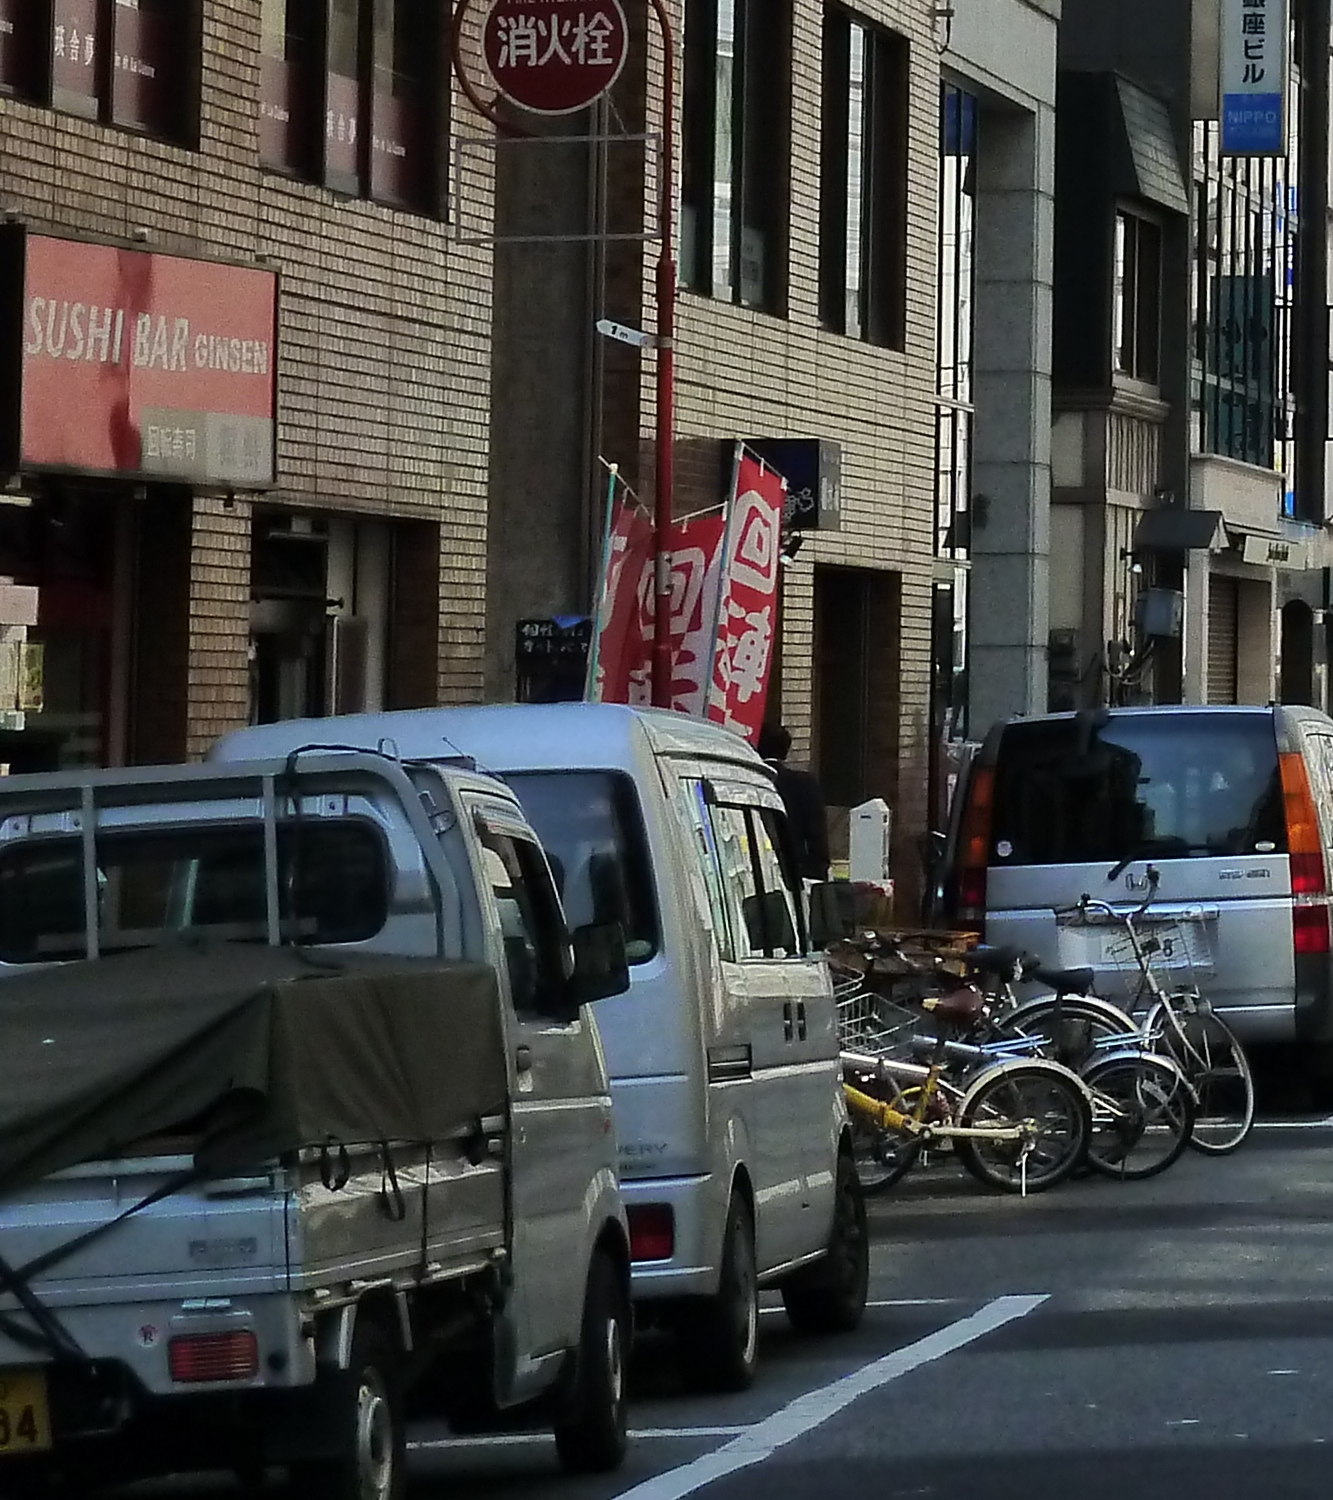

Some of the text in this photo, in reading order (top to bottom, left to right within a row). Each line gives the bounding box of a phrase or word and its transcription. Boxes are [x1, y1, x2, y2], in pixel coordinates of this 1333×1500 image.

[497, 12, 613, 68] 消火栓
[1227, 110, 1277, 125] NIPPO
[24, 296, 267, 374] SUSHI BAR GINSEN
[618, 1142, 669, 1155] VERY
